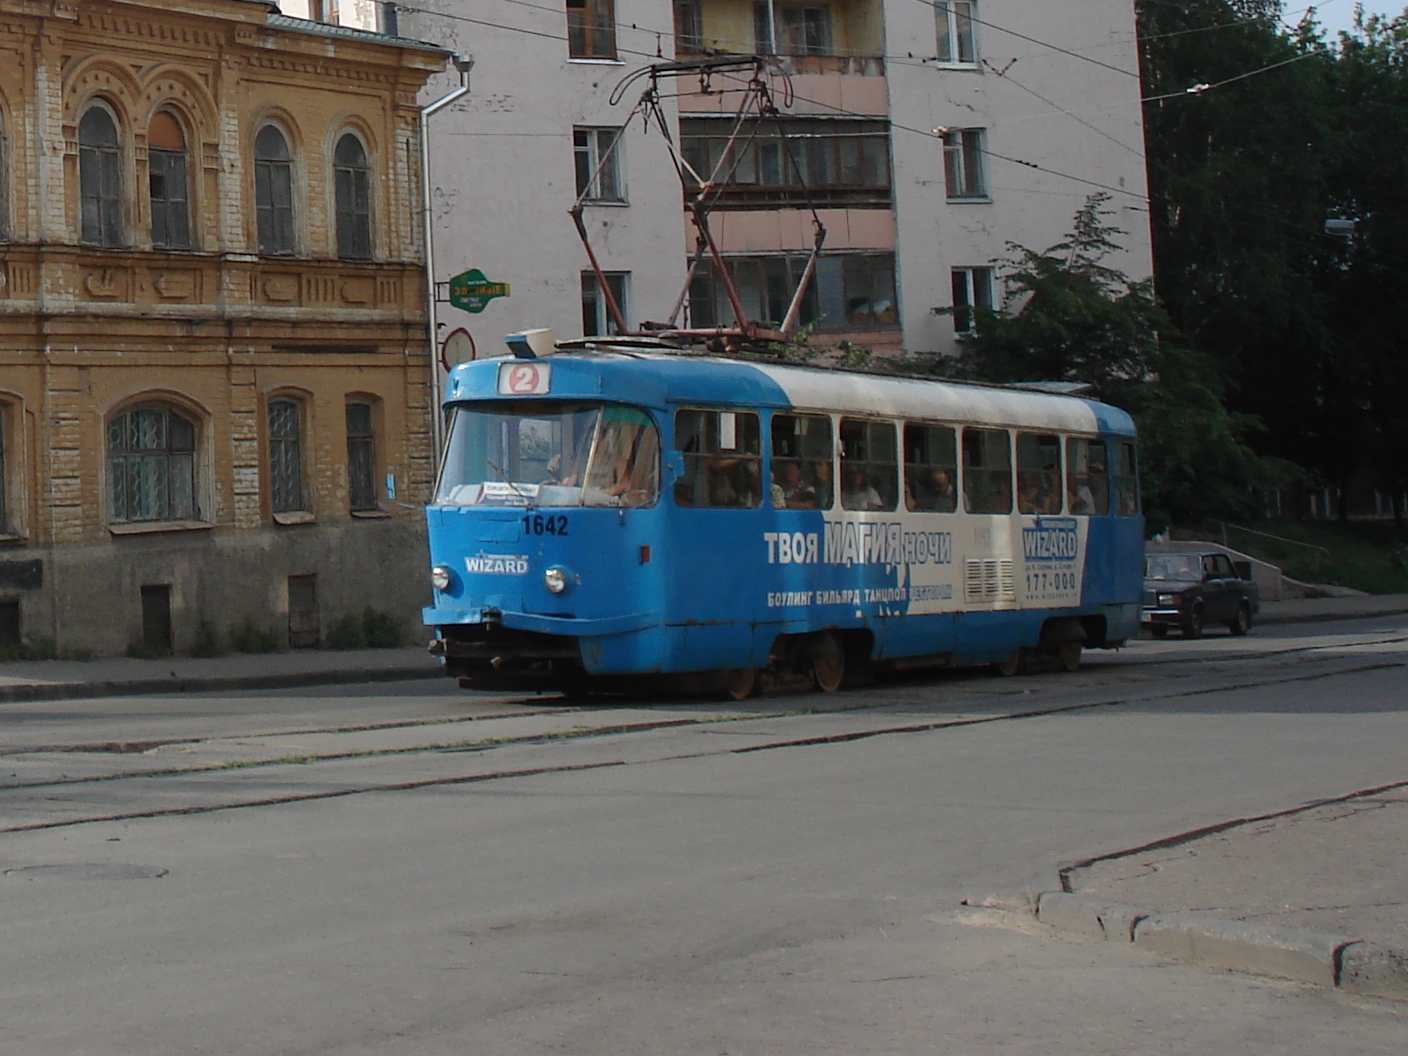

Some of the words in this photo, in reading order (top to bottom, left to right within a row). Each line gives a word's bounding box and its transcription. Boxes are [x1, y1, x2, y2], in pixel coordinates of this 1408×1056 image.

[514, 366, 534, 391] 2
[522, 515, 569, 536] 1642
[764, 532, 819, 564] ТВОЯ
[823, 521, 902, 565] МАГИЯ
[904, 532, 952, 564] НОЧИ
[1023, 528, 1078, 558] WIZARD
[465, 558, 528, 573] WIZARD
[767, 590, 813, 607] БОУЛИНГ
[816, 589, 861, 605] БИЛЬЯРД
